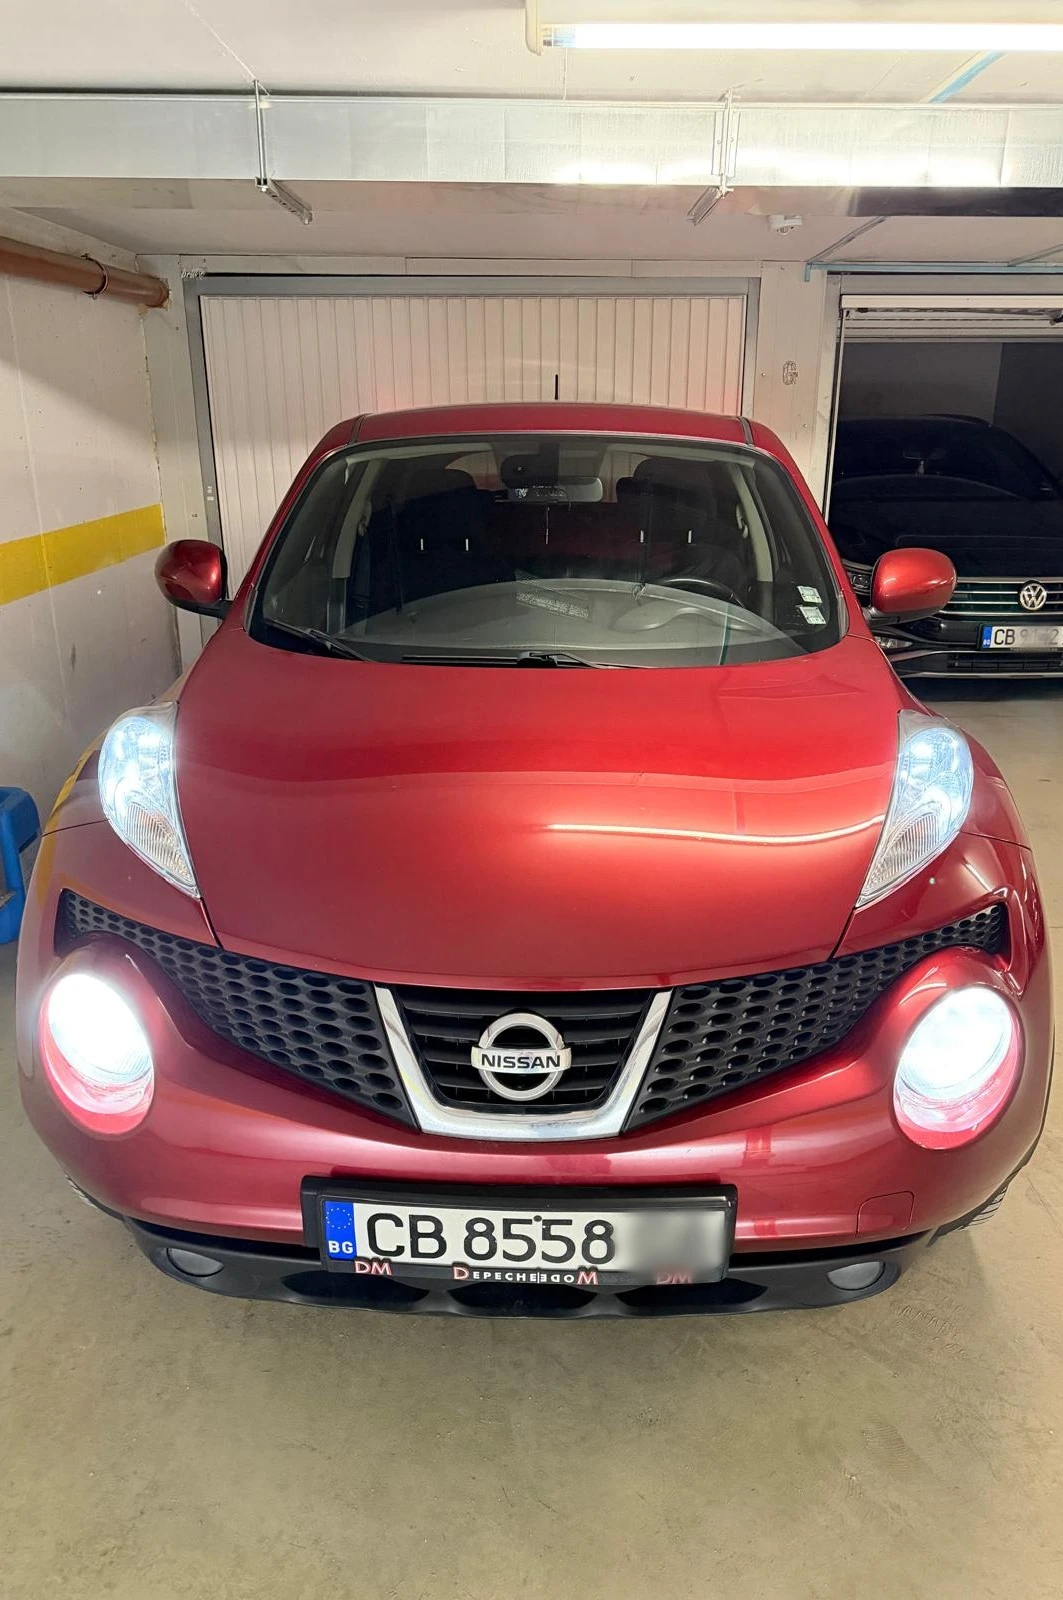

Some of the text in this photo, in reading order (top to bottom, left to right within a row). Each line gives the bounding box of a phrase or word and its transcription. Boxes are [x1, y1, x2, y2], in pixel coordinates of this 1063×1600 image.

[994, 629, 1016, 645] CB
[481, 1054, 560, 1069] NISSAN
[367, 1212, 447, 1258] CB
[463, 1217, 616, 1265] 8558
[328, 1240, 354, 1254] BG
[354, 1260, 393, 1276] DM
